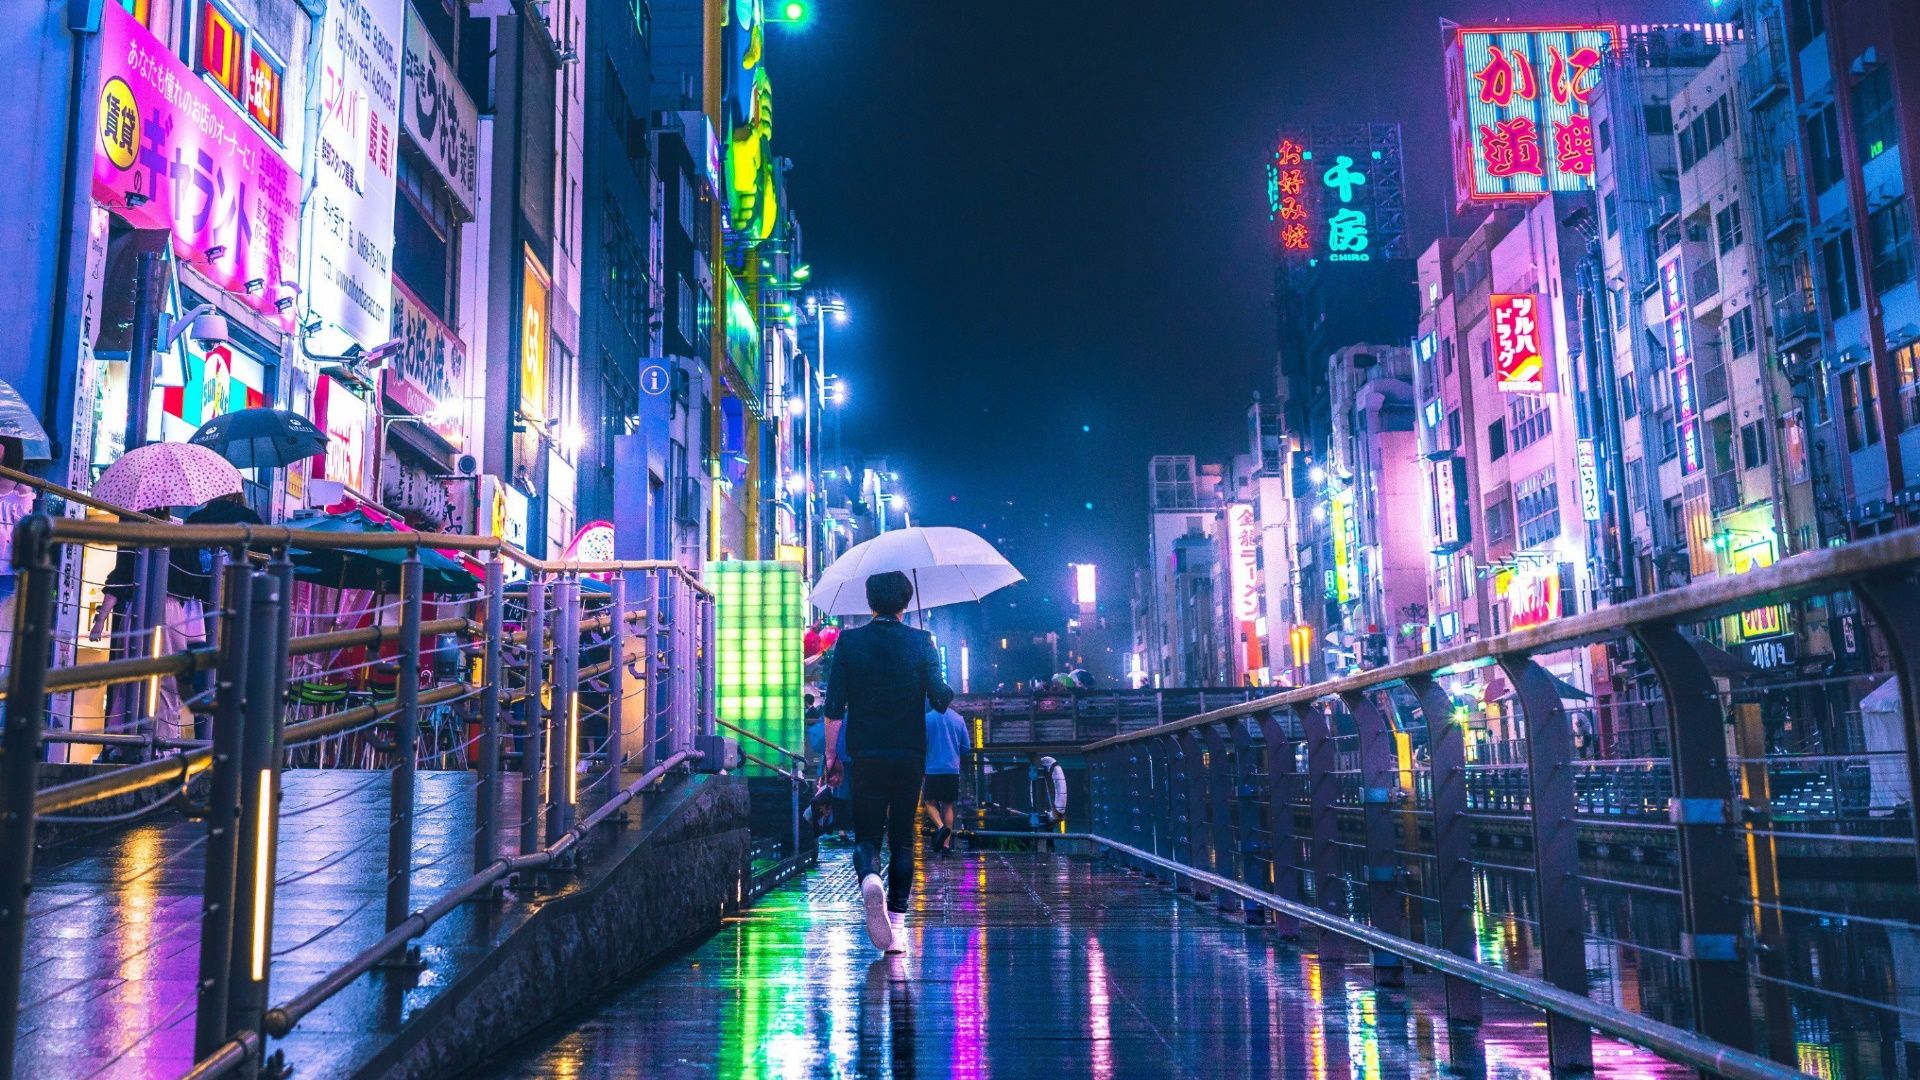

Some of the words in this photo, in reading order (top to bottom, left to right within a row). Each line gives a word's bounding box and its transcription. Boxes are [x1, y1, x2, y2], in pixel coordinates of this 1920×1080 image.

[1475, 46, 1600, 107] かに
[139, 107, 255, 266] ギャラント
[1279, 140, 1309, 249] お好み焼
[1324, 155, 1369, 252] 千房
[1496, 308, 1516, 368] ドラッグ
[1512, 298, 1537, 354] ツルハ
[1238, 508, 1259, 616] 金龍ラーメン
